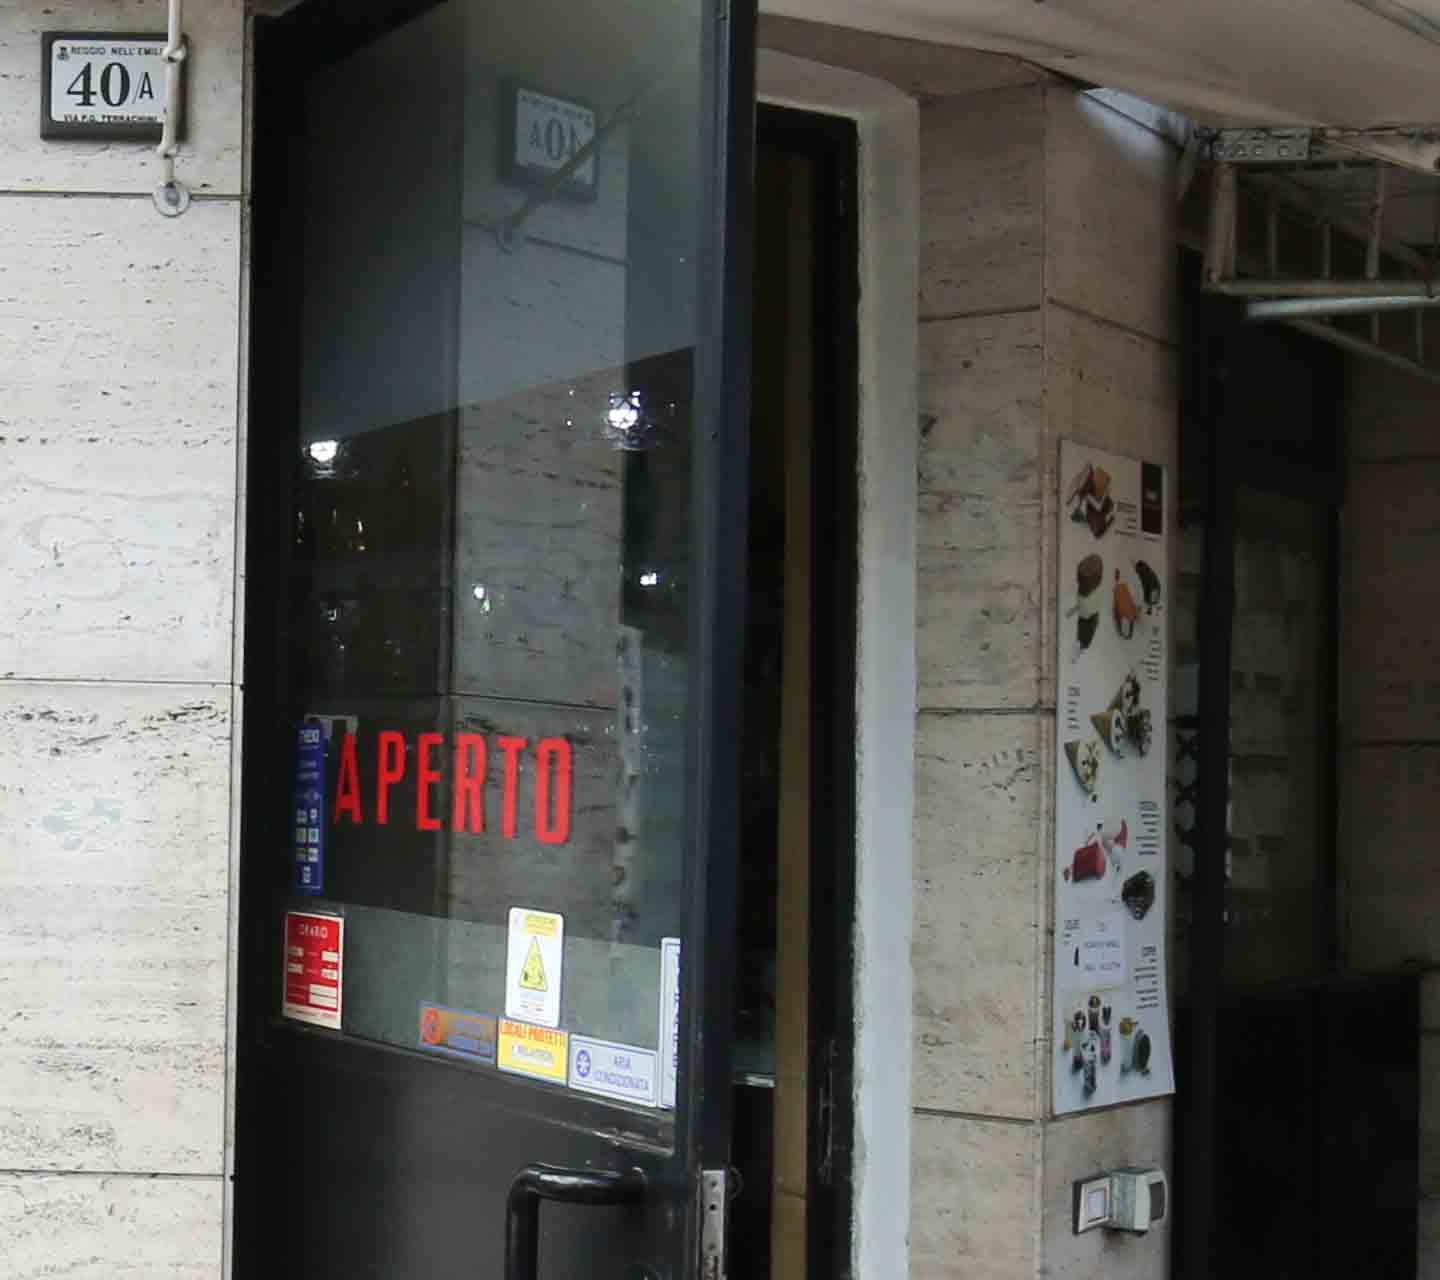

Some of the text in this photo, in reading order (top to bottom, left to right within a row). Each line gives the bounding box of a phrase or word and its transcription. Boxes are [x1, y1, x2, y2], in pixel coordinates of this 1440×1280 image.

[70, 45, 107, 56] REGGIO
[65, 61, 155, 107] 40/A
[333, 729, 574, 845] APERTO
